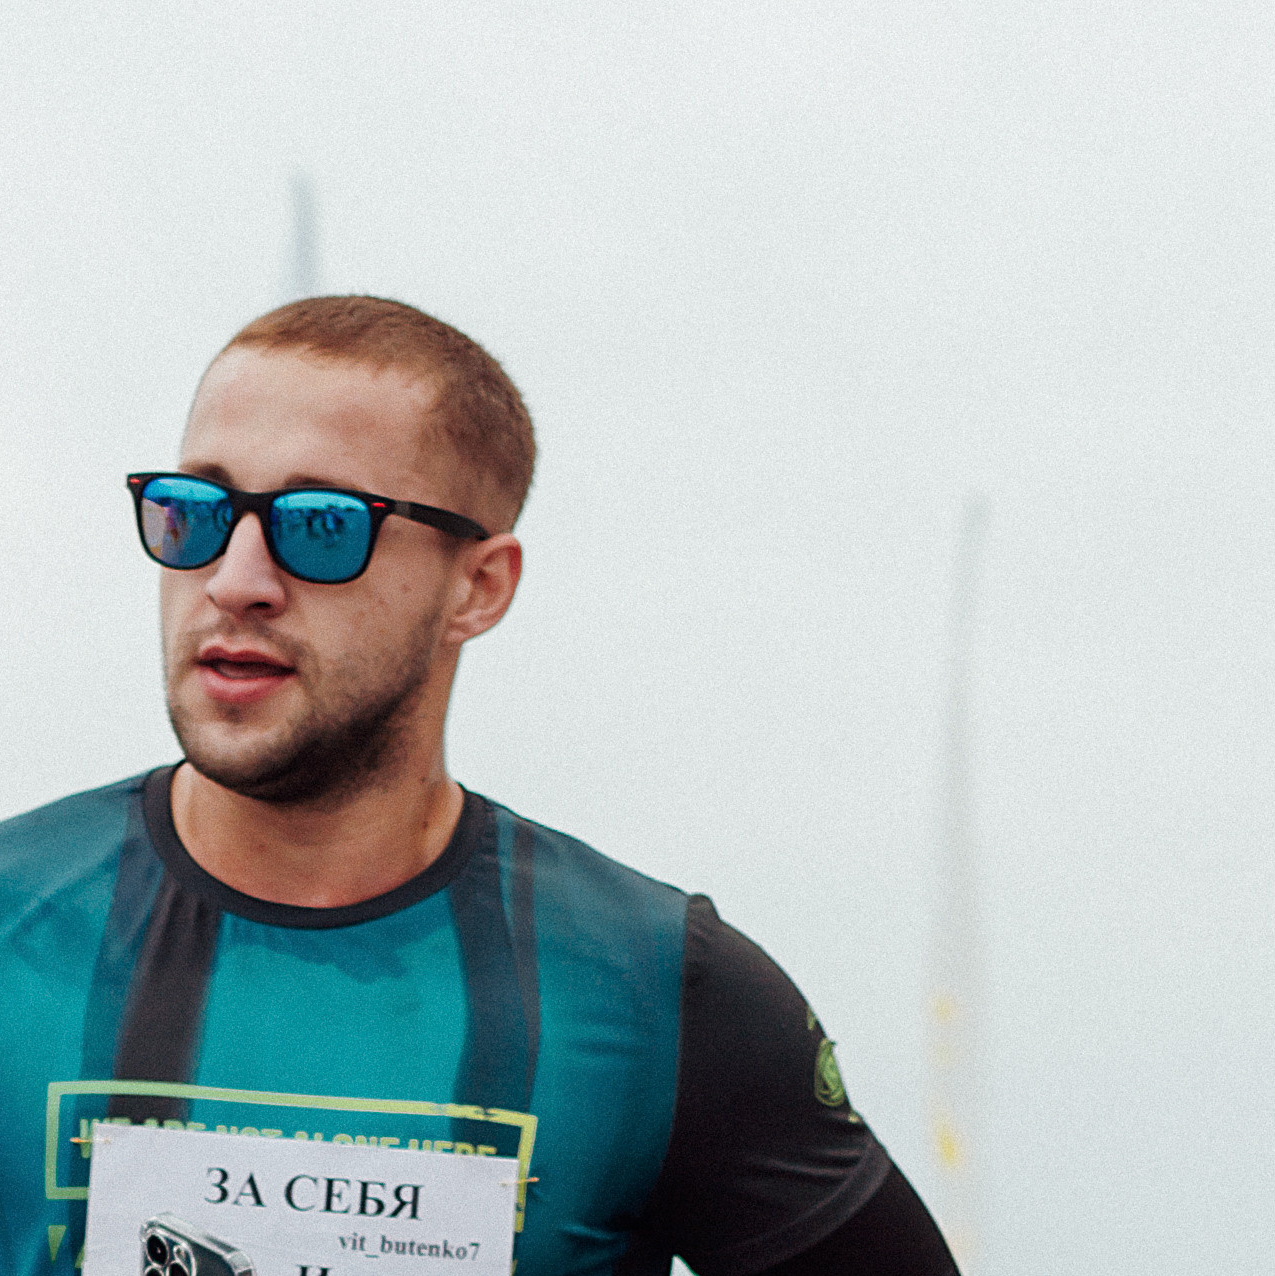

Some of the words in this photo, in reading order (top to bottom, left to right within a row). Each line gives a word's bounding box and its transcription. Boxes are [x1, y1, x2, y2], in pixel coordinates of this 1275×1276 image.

[204, 1167, 267, 1208] ЗА
[284, 1174, 424, 1221] СЕБЯ
[338, 1232, 481, 1261] vit_butenko7
